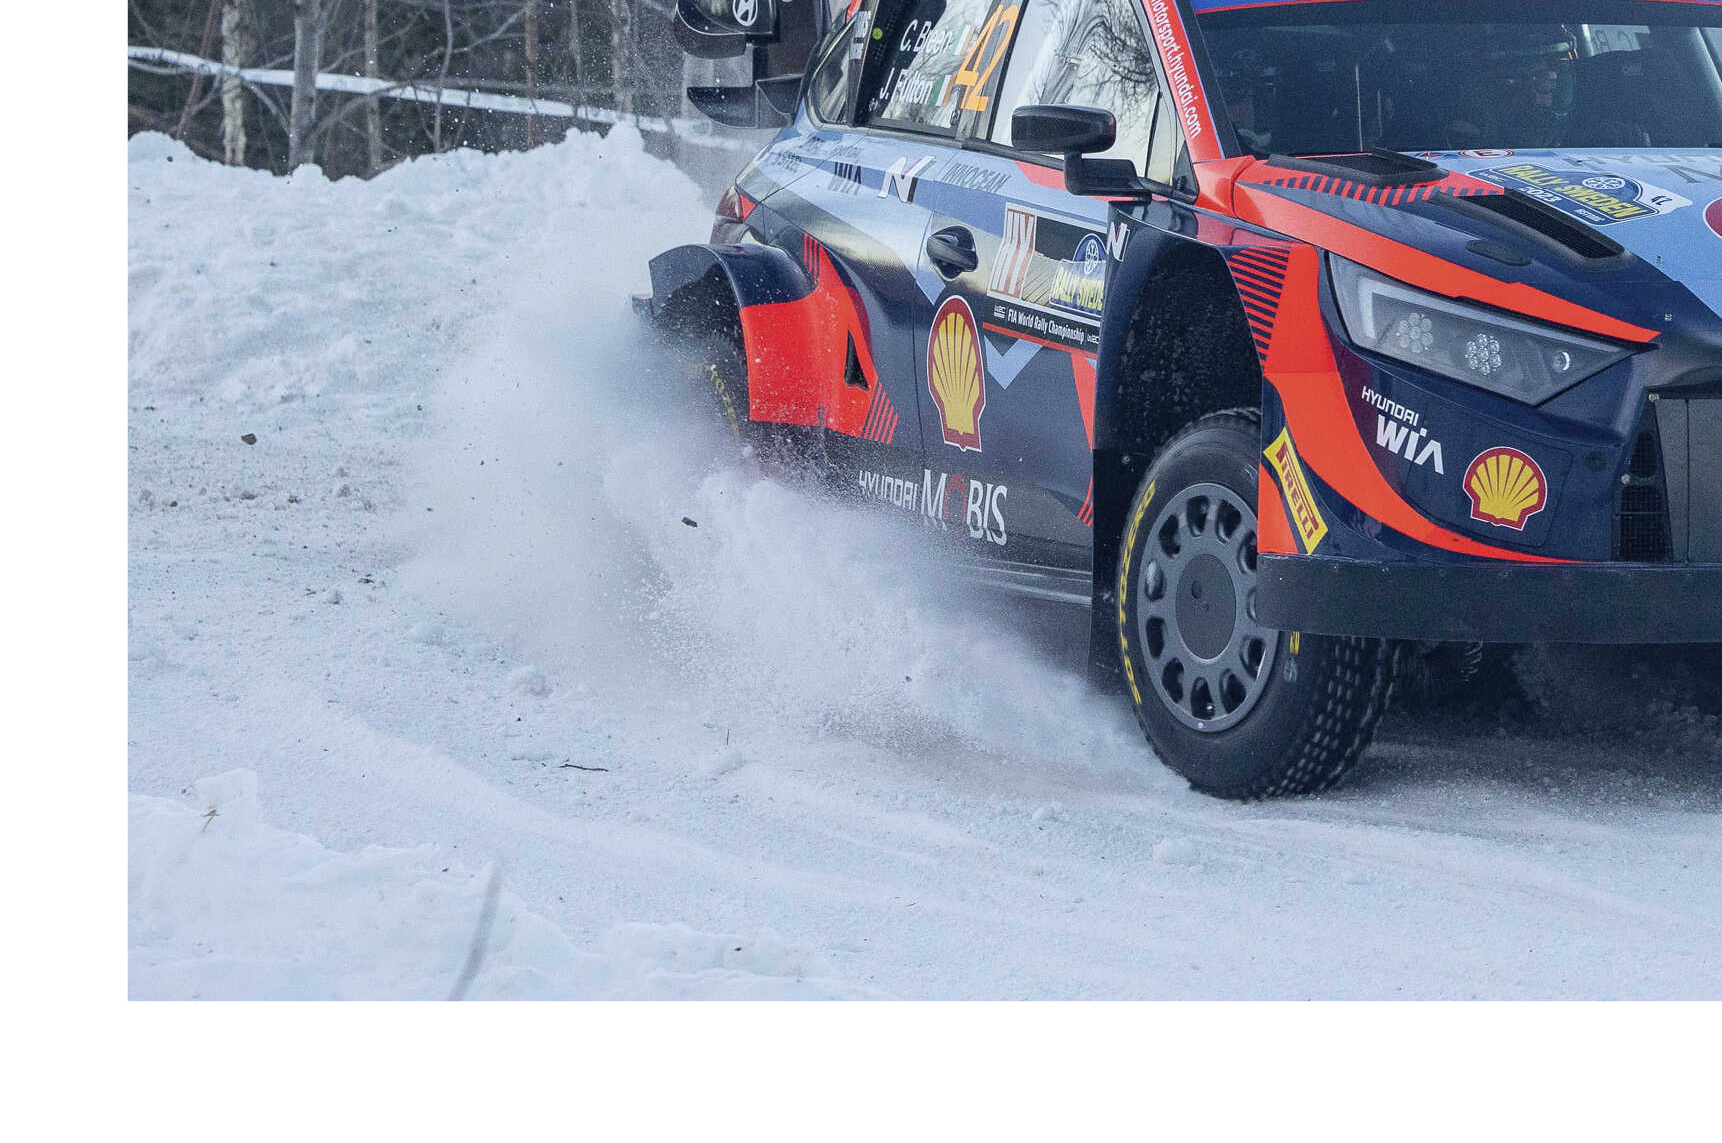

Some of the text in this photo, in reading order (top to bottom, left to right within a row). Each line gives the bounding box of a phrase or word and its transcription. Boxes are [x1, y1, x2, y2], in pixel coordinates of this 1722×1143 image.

[900, 19, 918, 52] C.
[914, 20, 953, 55] Breen
[955, 4, 1020, 112] 42
[879, 67, 935, 105] J. Fulton
[1501, 164, 1570, 186] RALLY
[1554, 184, 1648, 217] SWEDEN
[1519, 185, 1563, 203] 2023
[1008, 308, 1017, 324] FIA
[1018, 311, 1034, 328] World
[1034, 315, 1048, 335] Rally
[1048, 320, 1085, 345] Championship
[1361, 385, 1420, 427] HYUNDAI
[858, 468, 1009, 547] HYUNDAI MOBIS
[1275, 441, 1320, 540] PIRELLI
